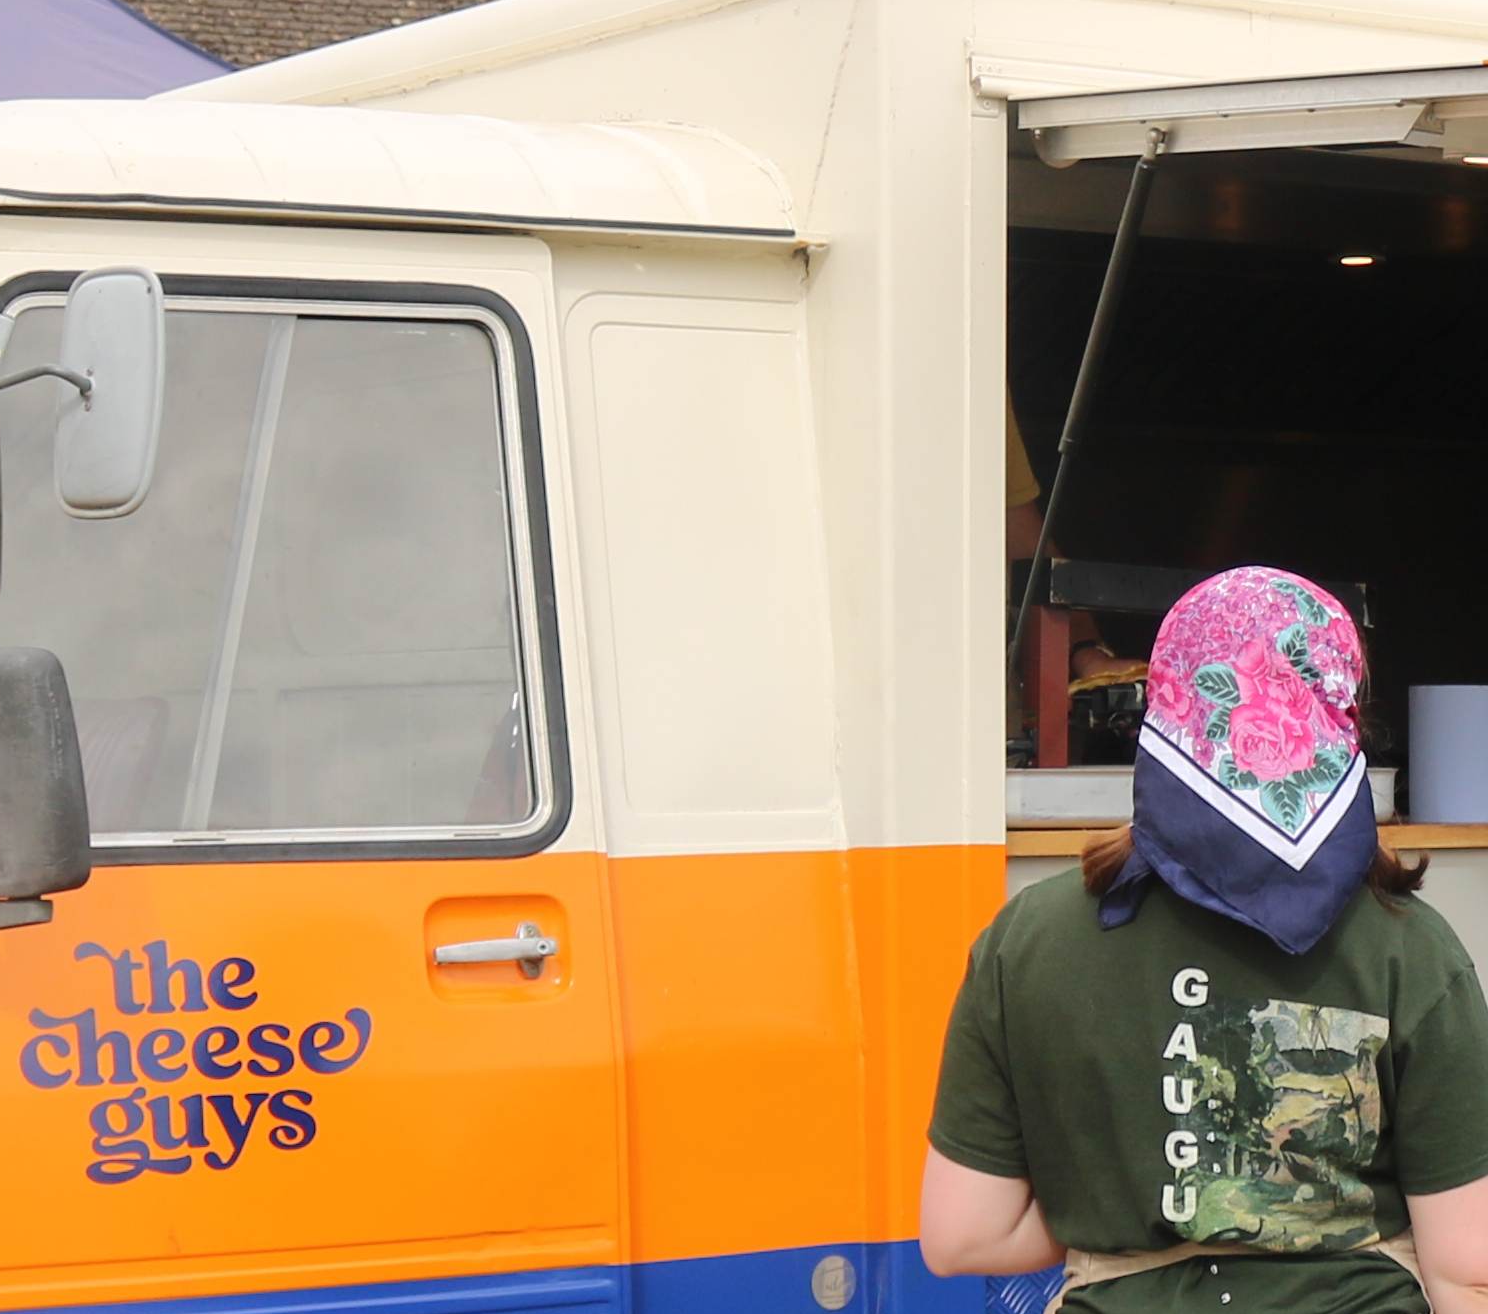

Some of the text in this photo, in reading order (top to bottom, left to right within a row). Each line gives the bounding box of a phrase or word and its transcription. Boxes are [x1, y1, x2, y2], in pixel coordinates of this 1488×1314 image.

[73, 939, 259, 1016] the
[19, 1007, 373, 1090] cheese
[85, 1086, 318, 1185] guys
[1161, 967, 1210, 1223] GAUGU
